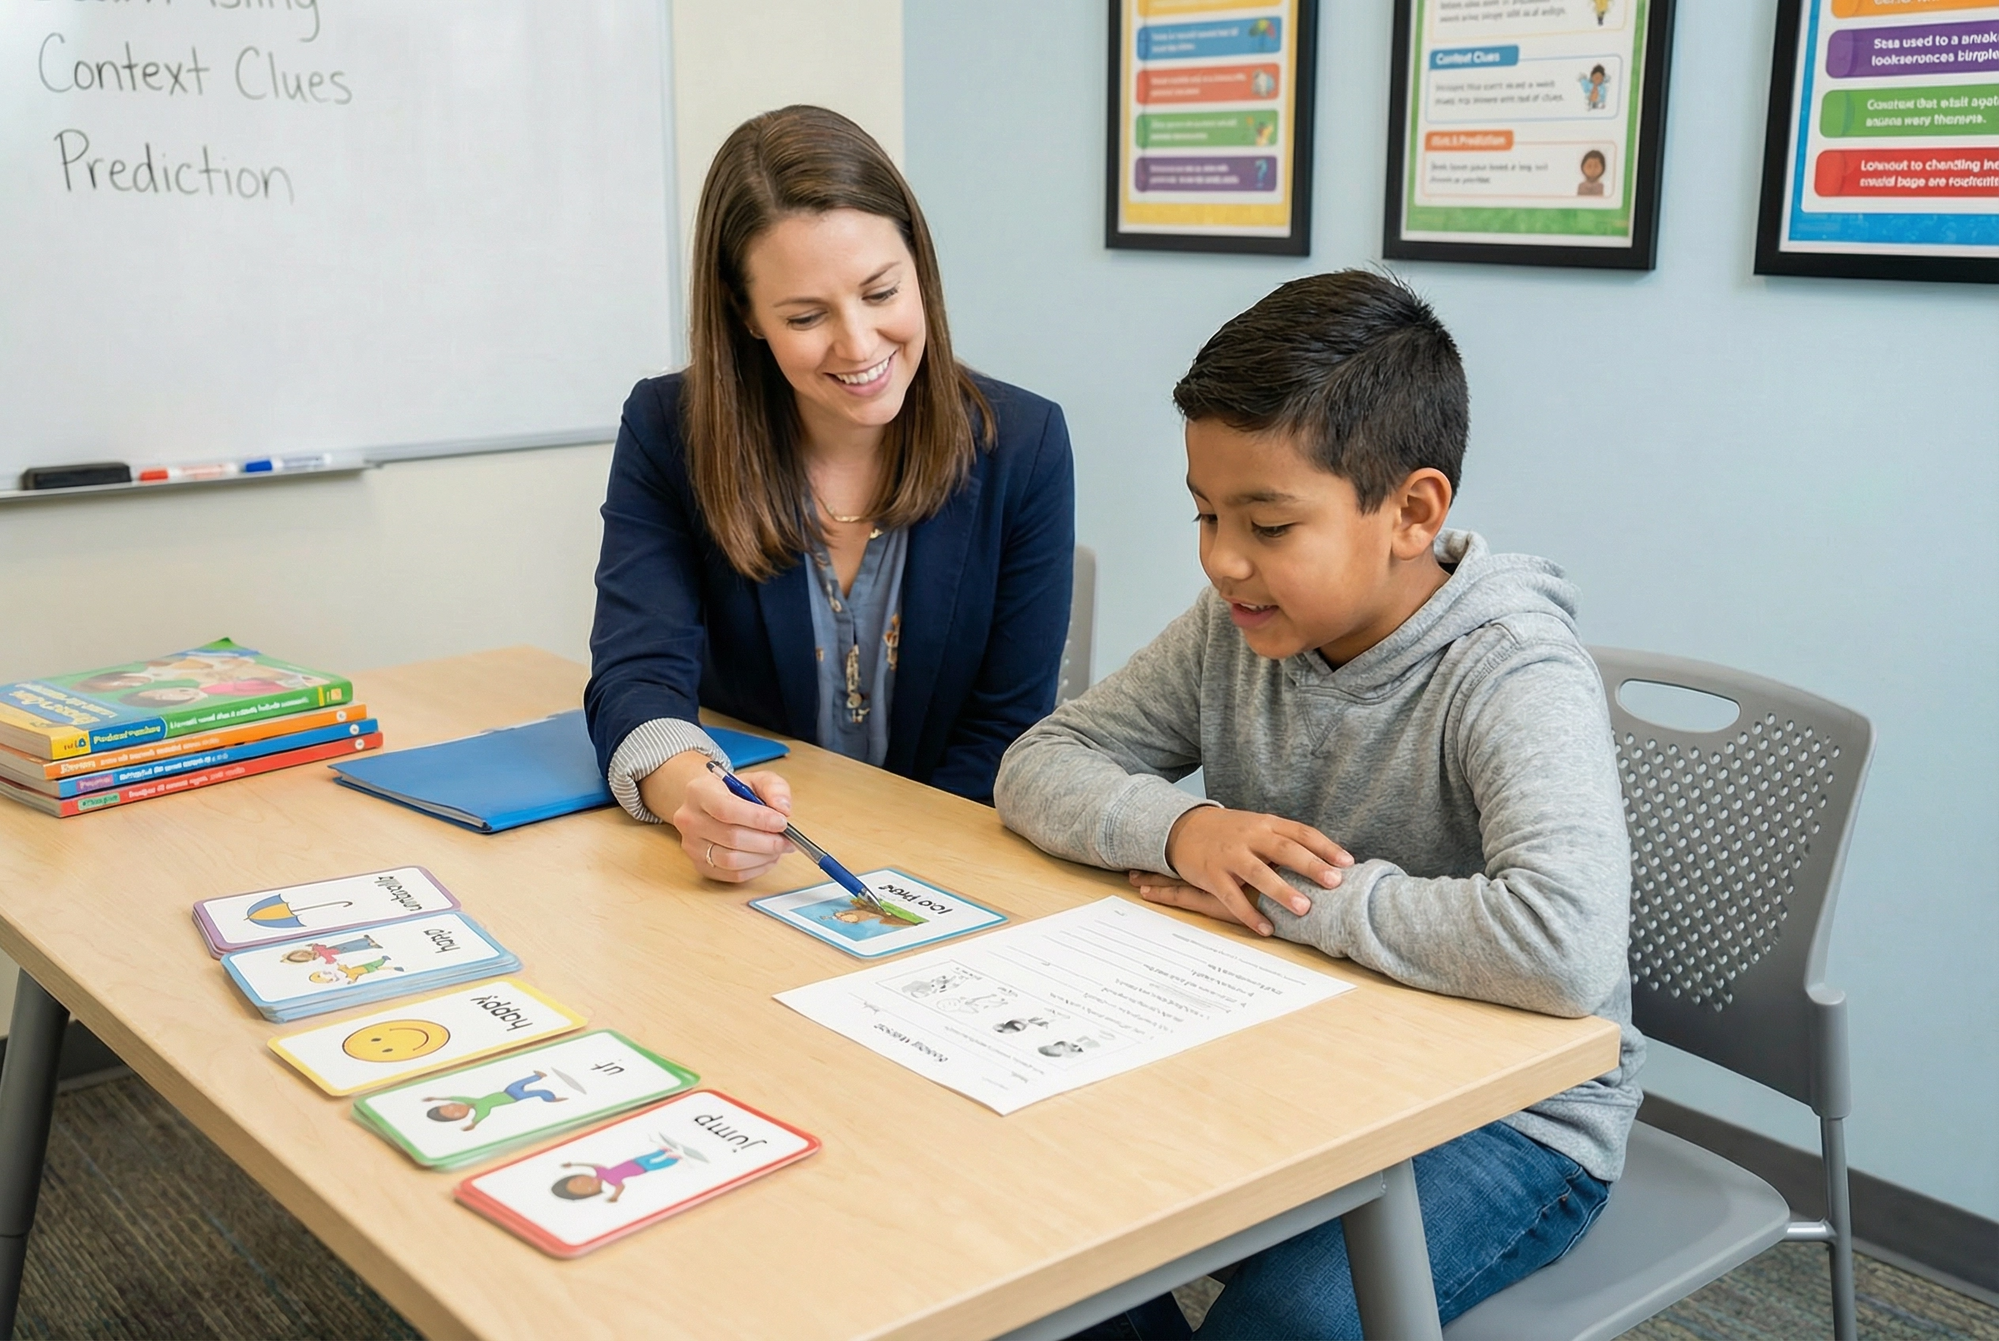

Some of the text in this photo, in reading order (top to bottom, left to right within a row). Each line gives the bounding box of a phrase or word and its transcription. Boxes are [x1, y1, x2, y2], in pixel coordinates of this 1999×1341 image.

[1902, 35, 1933, 48] used
[1935, 35, 1949, 46] to
[38, 32, 353, 105] Context Clues
[54, 128, 295, 206] Prediction
[1910, 160, 1923, 171] to
[470, 995, 534, 1032] happy
[694, 1114, 768, 1153] jump
